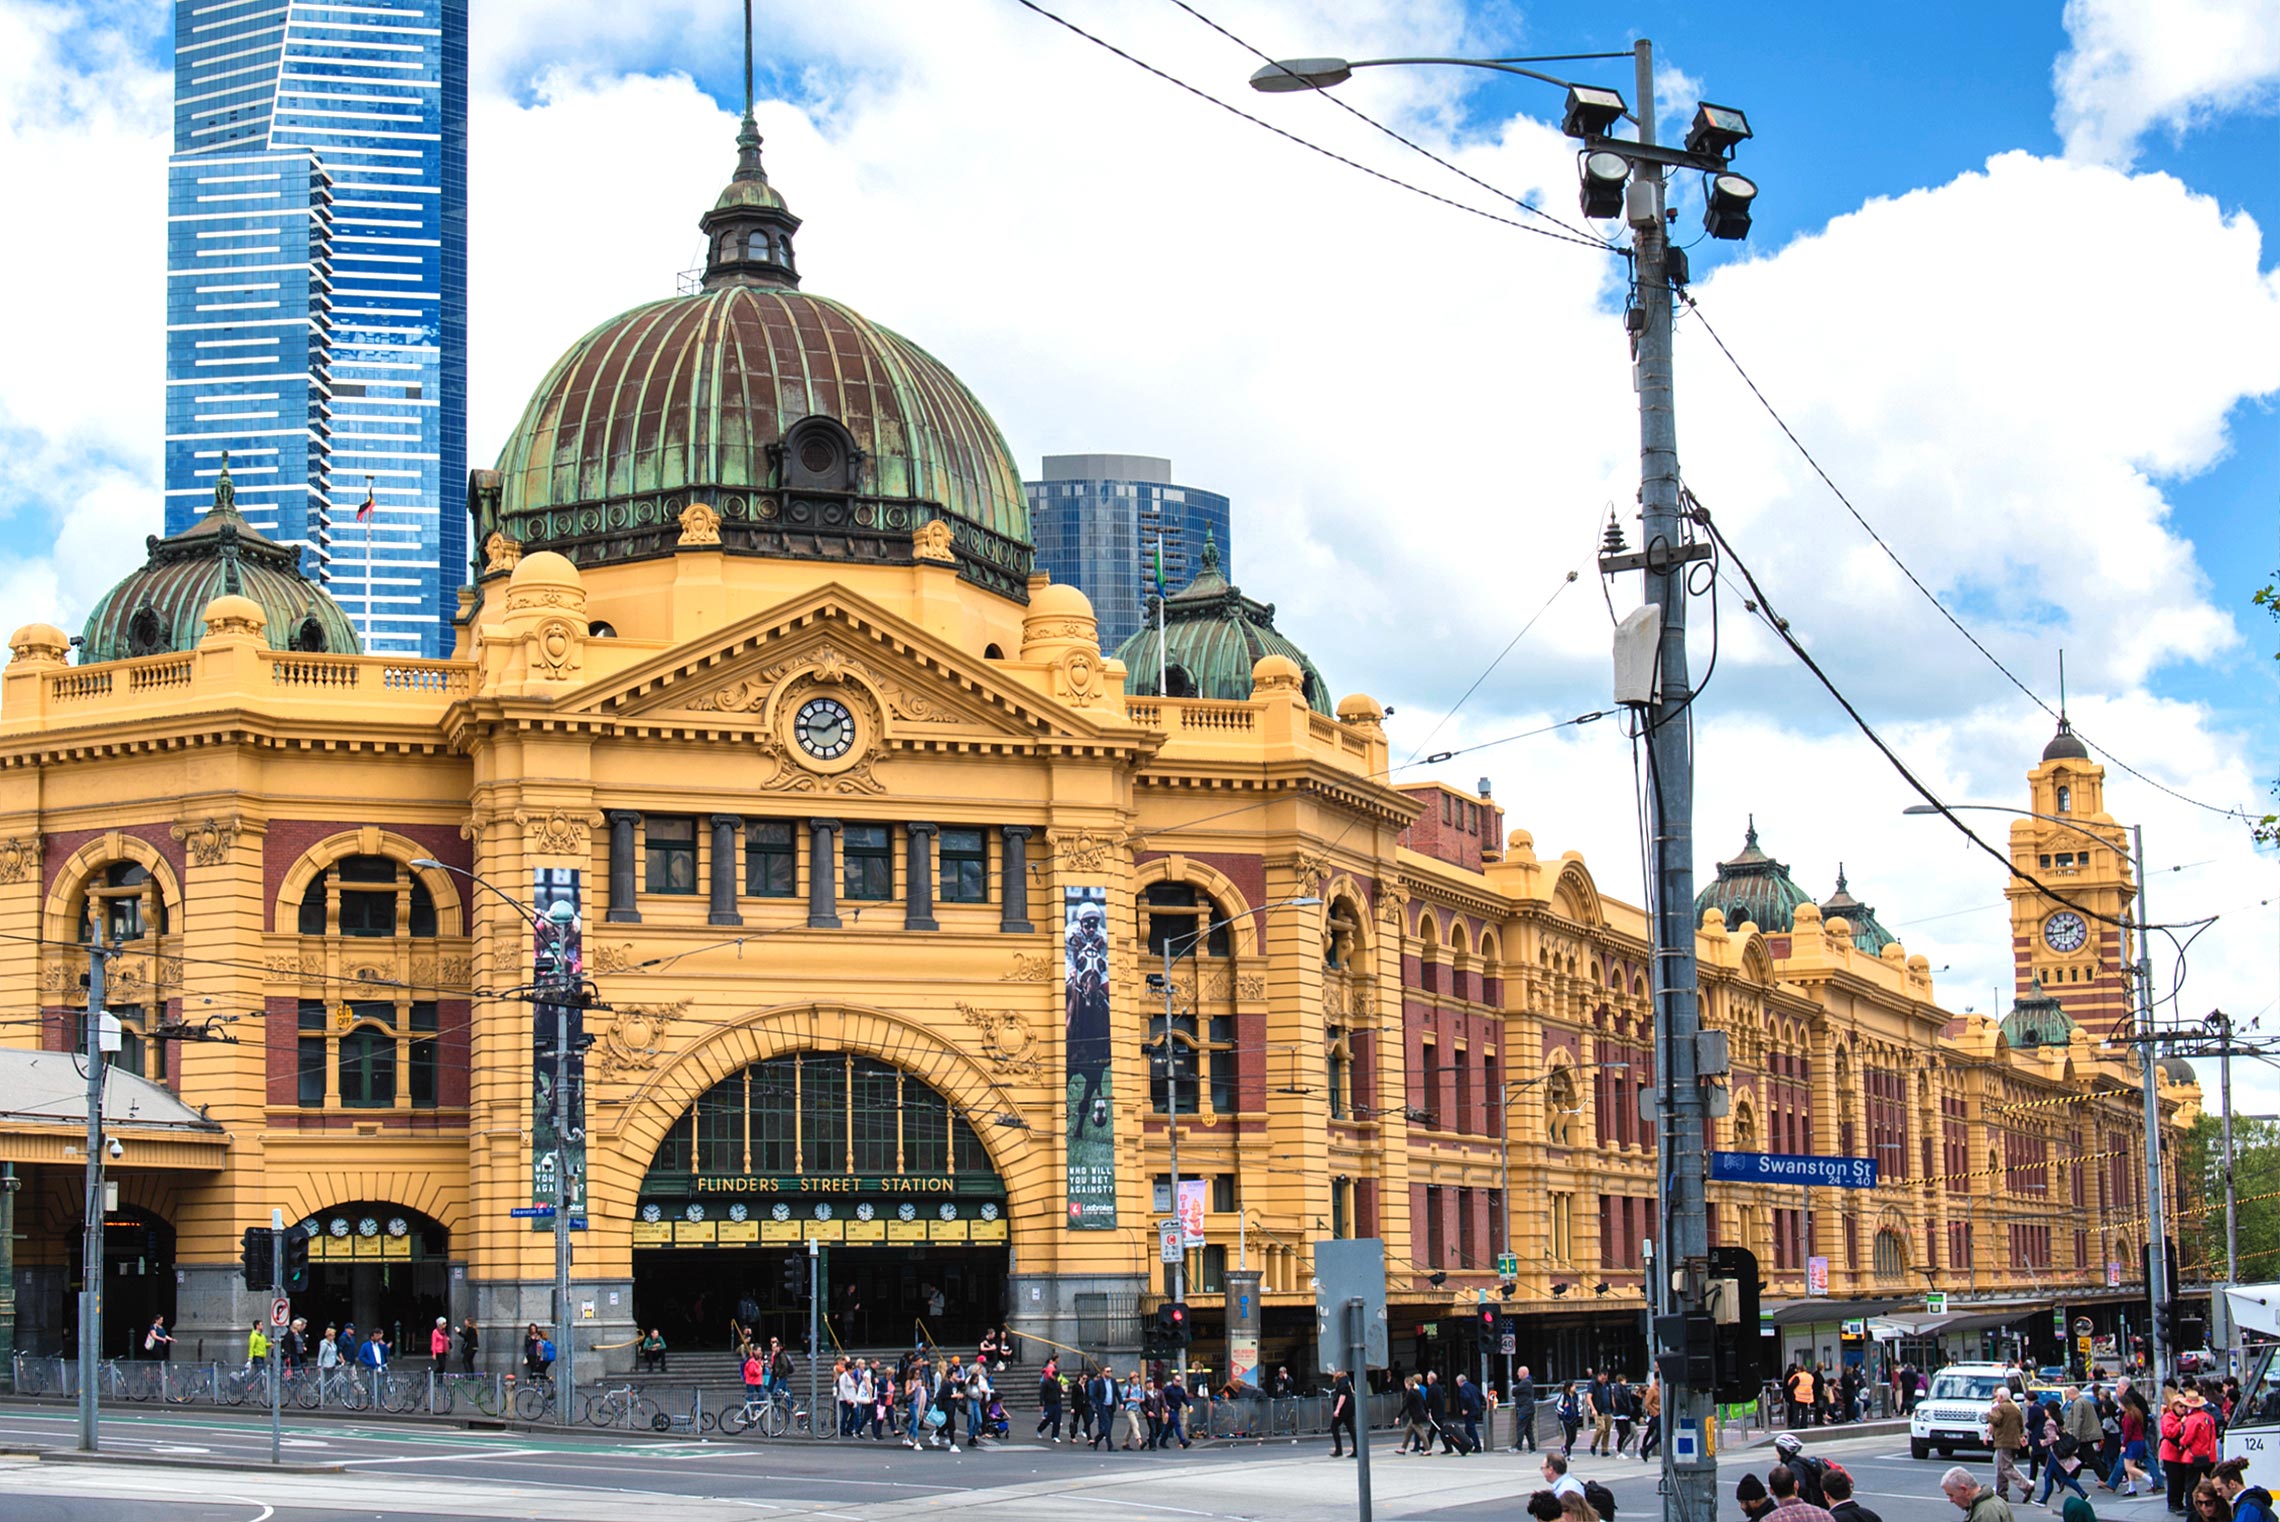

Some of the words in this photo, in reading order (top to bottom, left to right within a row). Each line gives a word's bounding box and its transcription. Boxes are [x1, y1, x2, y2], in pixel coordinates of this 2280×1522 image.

[1069, 1166, 1086, 1174] WHO
[1091, 1166, 1112, 1174] WILL
[1759, 1156, 1846, 1176] Swanston
[1852, 1160, 1871, 1178] St
[535, 1174, 554, 1182] YOU
[1069, 1176, 1086, 1184] YOU
[1092, 1176, 1108, 1184] BET
[1828, 1174, 1840, 1184] 24
[1856, 1176, 1870, 1186] 40
[698, 1178, 779, 1191] FLINDERS
[800, 1178, 862, 1191] STREET
[881, 1178, 954, 1192] STATION
[1070, 1185, 1113, 1194] AGAINST?
[1167, 1234, 1176, 1246] C
[1502, 1340, 1514, 1348] 40
[2245, 1438, 2264, 1450] 124
